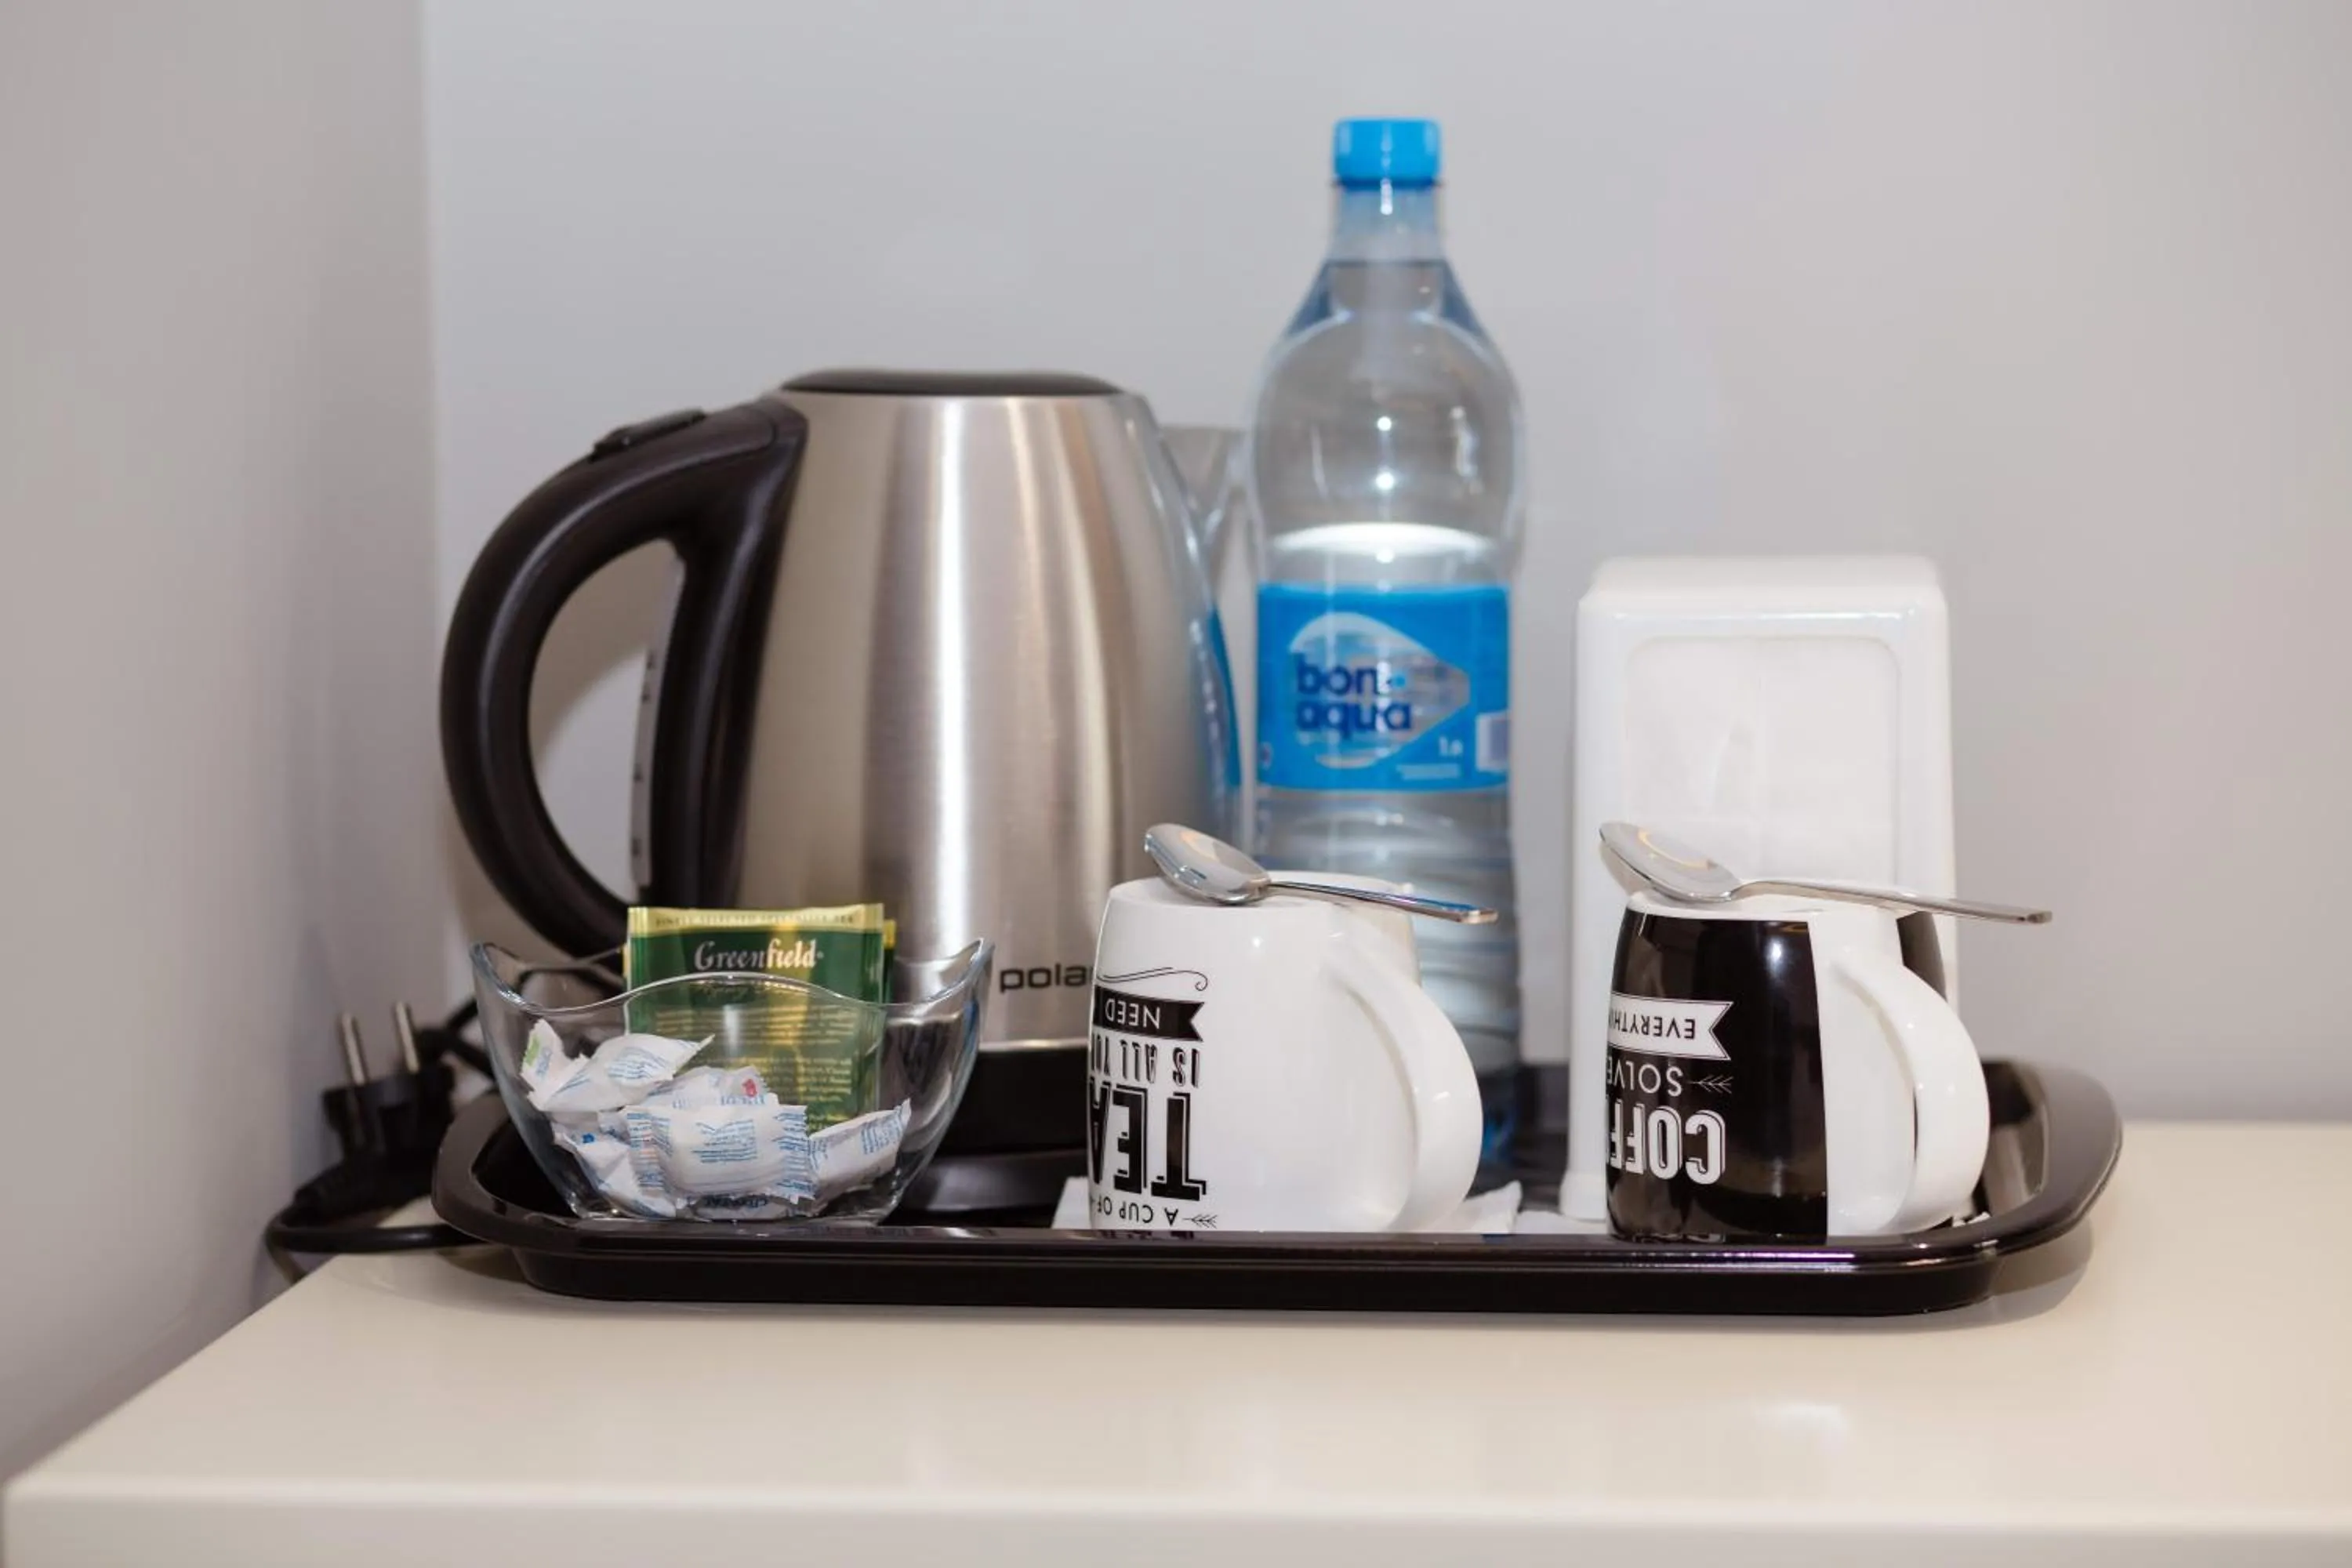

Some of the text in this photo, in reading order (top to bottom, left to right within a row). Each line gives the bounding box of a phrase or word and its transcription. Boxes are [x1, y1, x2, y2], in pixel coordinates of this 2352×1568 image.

[1298, 702, 1410, 739] aqua
[695, 938, 817, 971] Greenfield
[1105, 998, 1160, 1029] NEED
[1120, 1040, 1158, 1084] ALL
[1173, 1047, 1200, 1088] IS
[1089, 1077, 1207, 1201] TEA
[1606, 1096, 1726, 1185] COFF
[1097, 1196, 1179, 1226] A CUP OF
